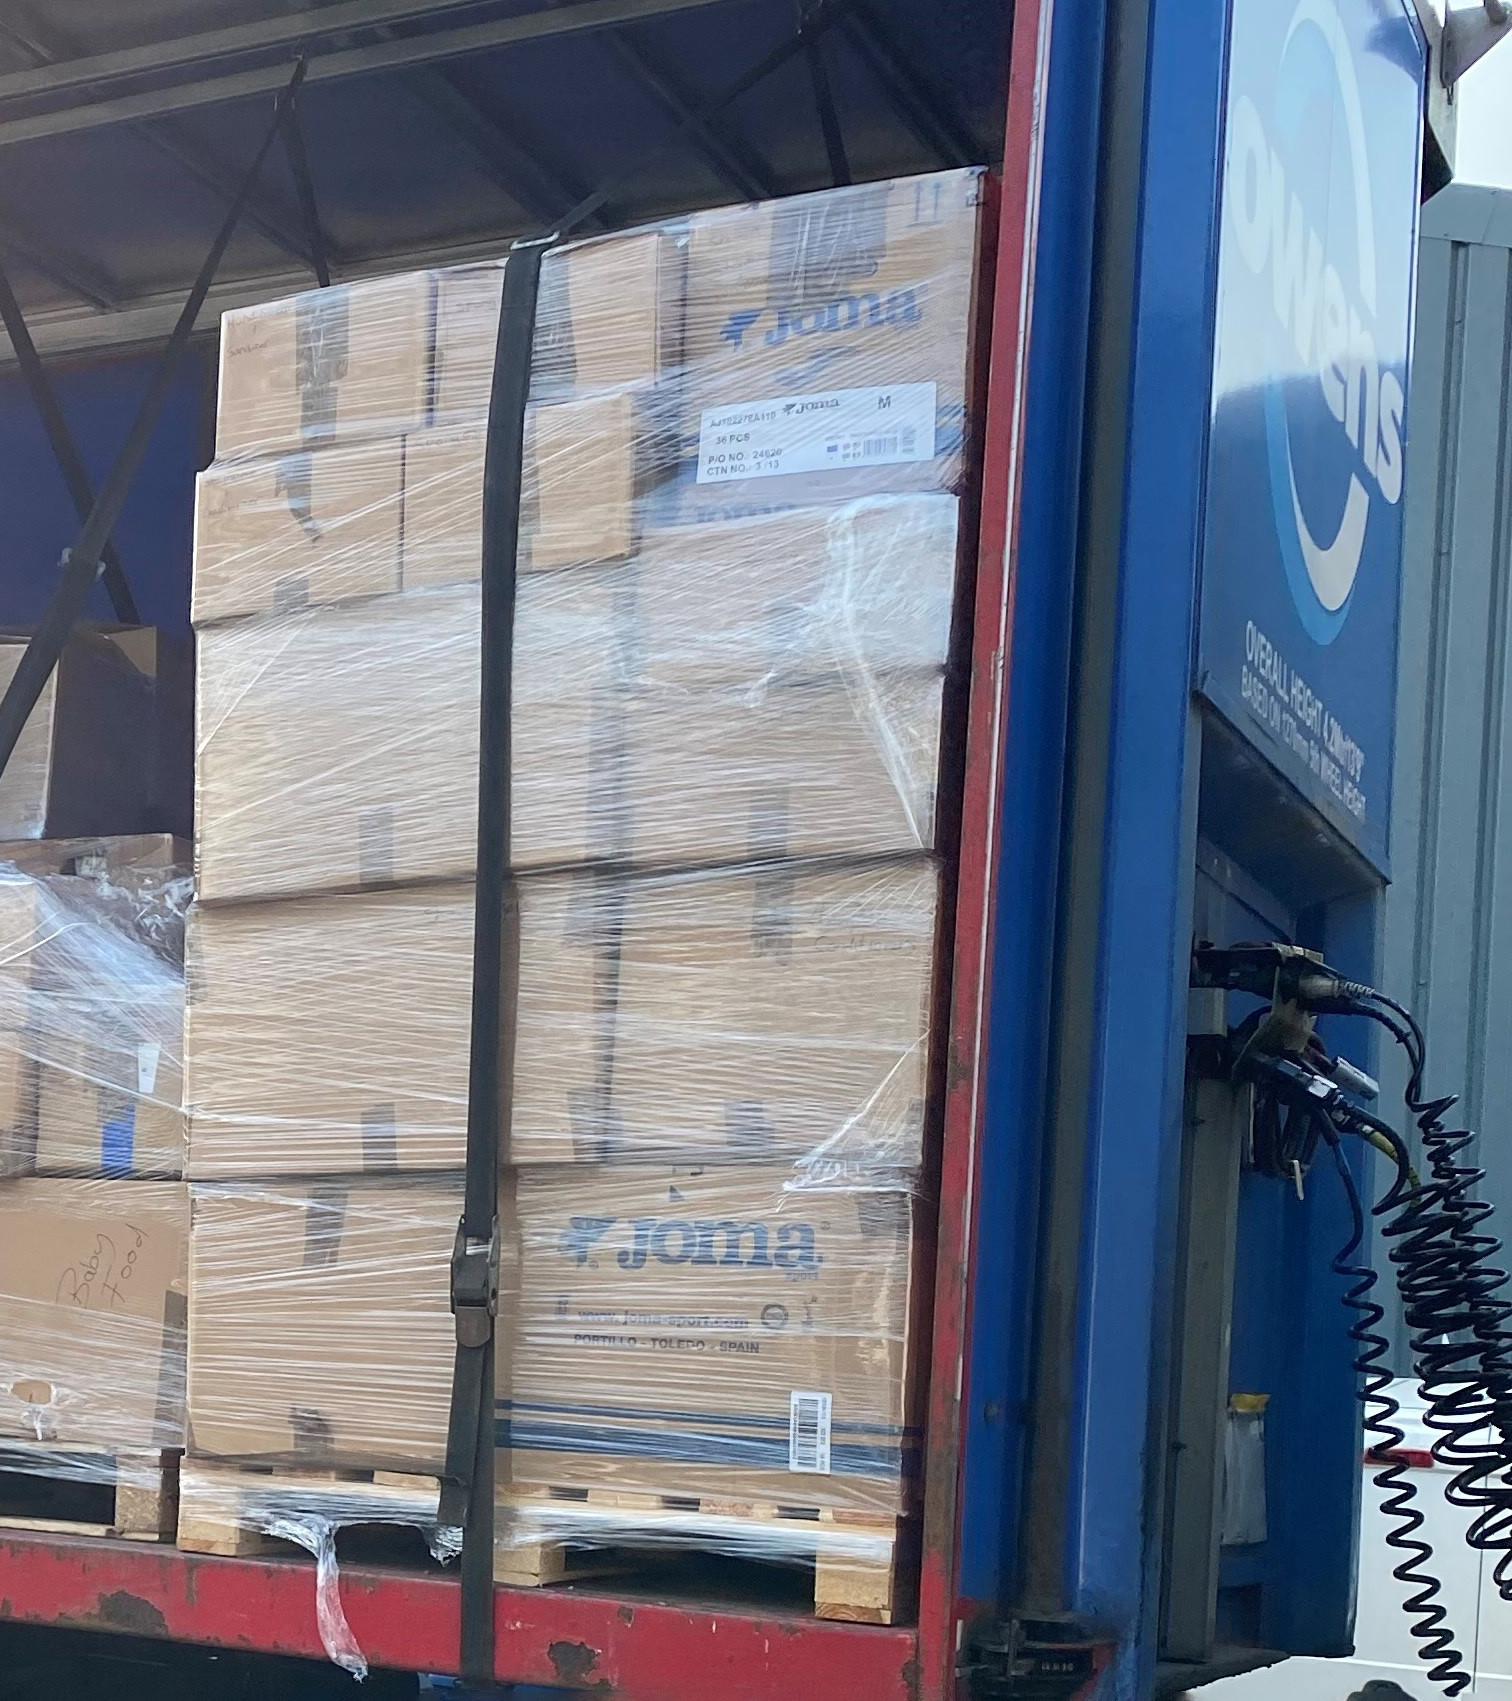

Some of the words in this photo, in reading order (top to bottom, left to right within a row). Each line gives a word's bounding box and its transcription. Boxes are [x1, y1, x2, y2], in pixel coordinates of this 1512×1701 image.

[1229, 95, 1404, 505] owens
[878, 395, 891, 410] M
[716, 435, 728, 445] 36
[729, 433, 750, 444] PCS
[706, 466, 728, 476] CTN
[1245, 619, 1290, 703] OVERALL
[1290, 669, 1323, 738] HEIGHT
[1241, 665, 1268, 718] BASED
[1269, 695, 1281, 734] ON
[617, 1218, 823, 1270] Joma
[574, 1333, 637, 1347] PORTILLO
[650, 1337, 705, 1350] TOLEDO
[719, 1340, 760, 1353] SPAIN
